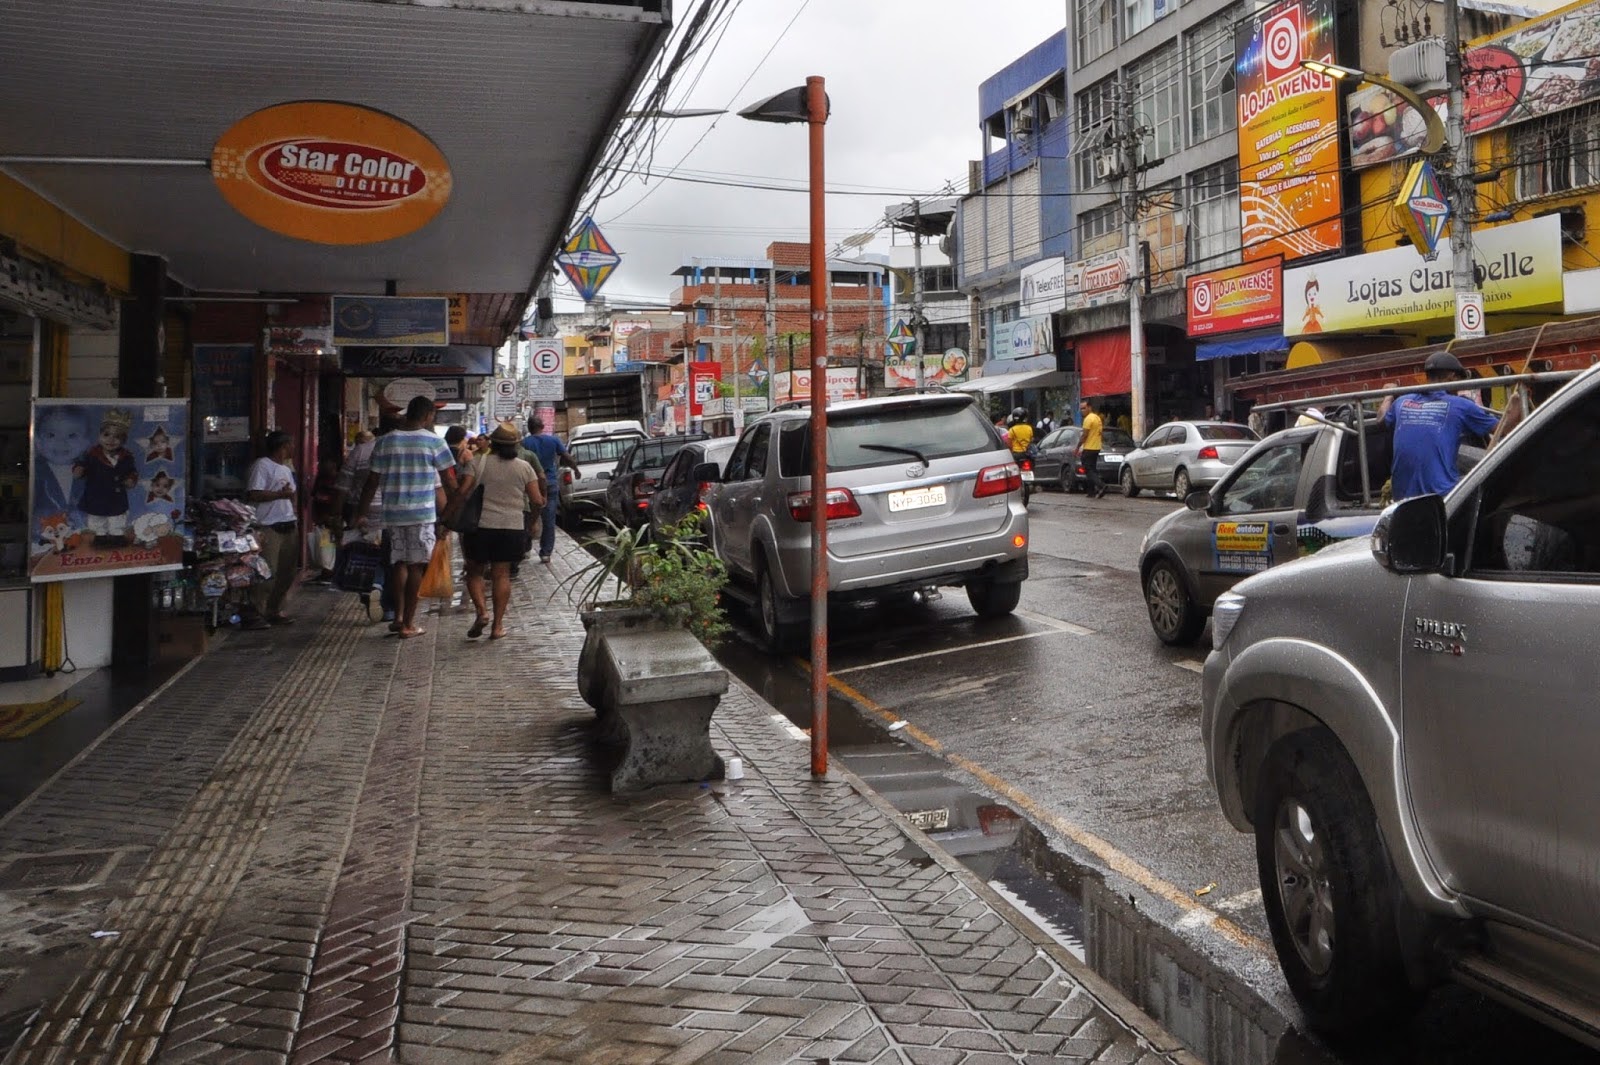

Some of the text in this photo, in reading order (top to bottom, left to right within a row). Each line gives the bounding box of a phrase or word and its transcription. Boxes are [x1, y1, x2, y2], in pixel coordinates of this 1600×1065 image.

[1240, 54, 1332, 127] LOJA WENSE
[1255, 119, 1320, 150] BATERIAS ACESSÓRIOS
[280, 144, 415, 180] Star Color
[1256, 161, 1284, 180] TECLADOS
[336, 177, 410, 195] DIGITAL
[1036, 274, 1064, 294] TelexFREE
[1087, 269, 1120, 290] TOCA DO SOM
[1213, 268, 1274, 303] LOJA WENSE
[1347, 251, 1535, 305] Lojas Clarbelle
[1365, 309, 1373, 319] A
[1374, 301, 1424, 317] Princesinha
[1425, 298, 1443, 311] dos
[1467, 309, 1475, 324] E
[542, 354, 551, 368] E
[502, 384, 510, 393] E
[1236, 524, 1263, 533] outdoor
[60, 552, 103, 567] Enzo
[1415, 617, 1466, 641] HILUX
